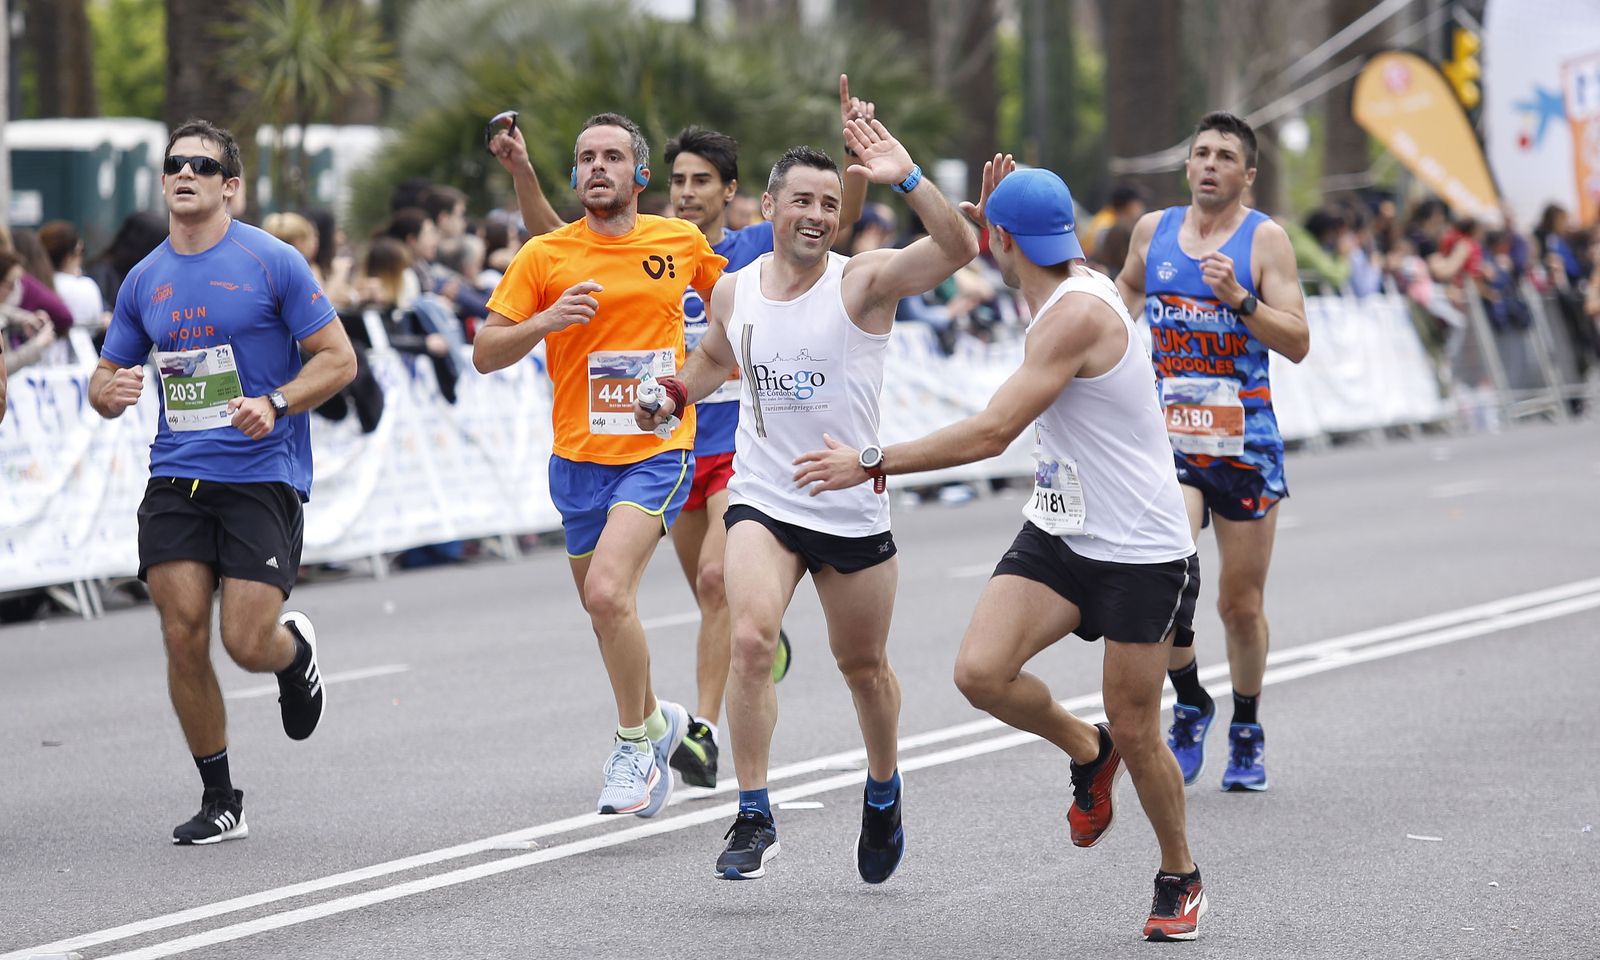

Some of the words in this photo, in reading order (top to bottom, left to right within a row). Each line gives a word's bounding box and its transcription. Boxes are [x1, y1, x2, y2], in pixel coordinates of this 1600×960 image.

[172, 306, 207, 322] RUN
[169, 325, 215, 341] YOUR
[1192, 330, 1248, 357] TUK
[169, 381, 207, 401] 2037
[752, 364, 826, 400] Priego
[598, 384, 639, 403] 441
[1170, 408, 1214, 427] 5180
